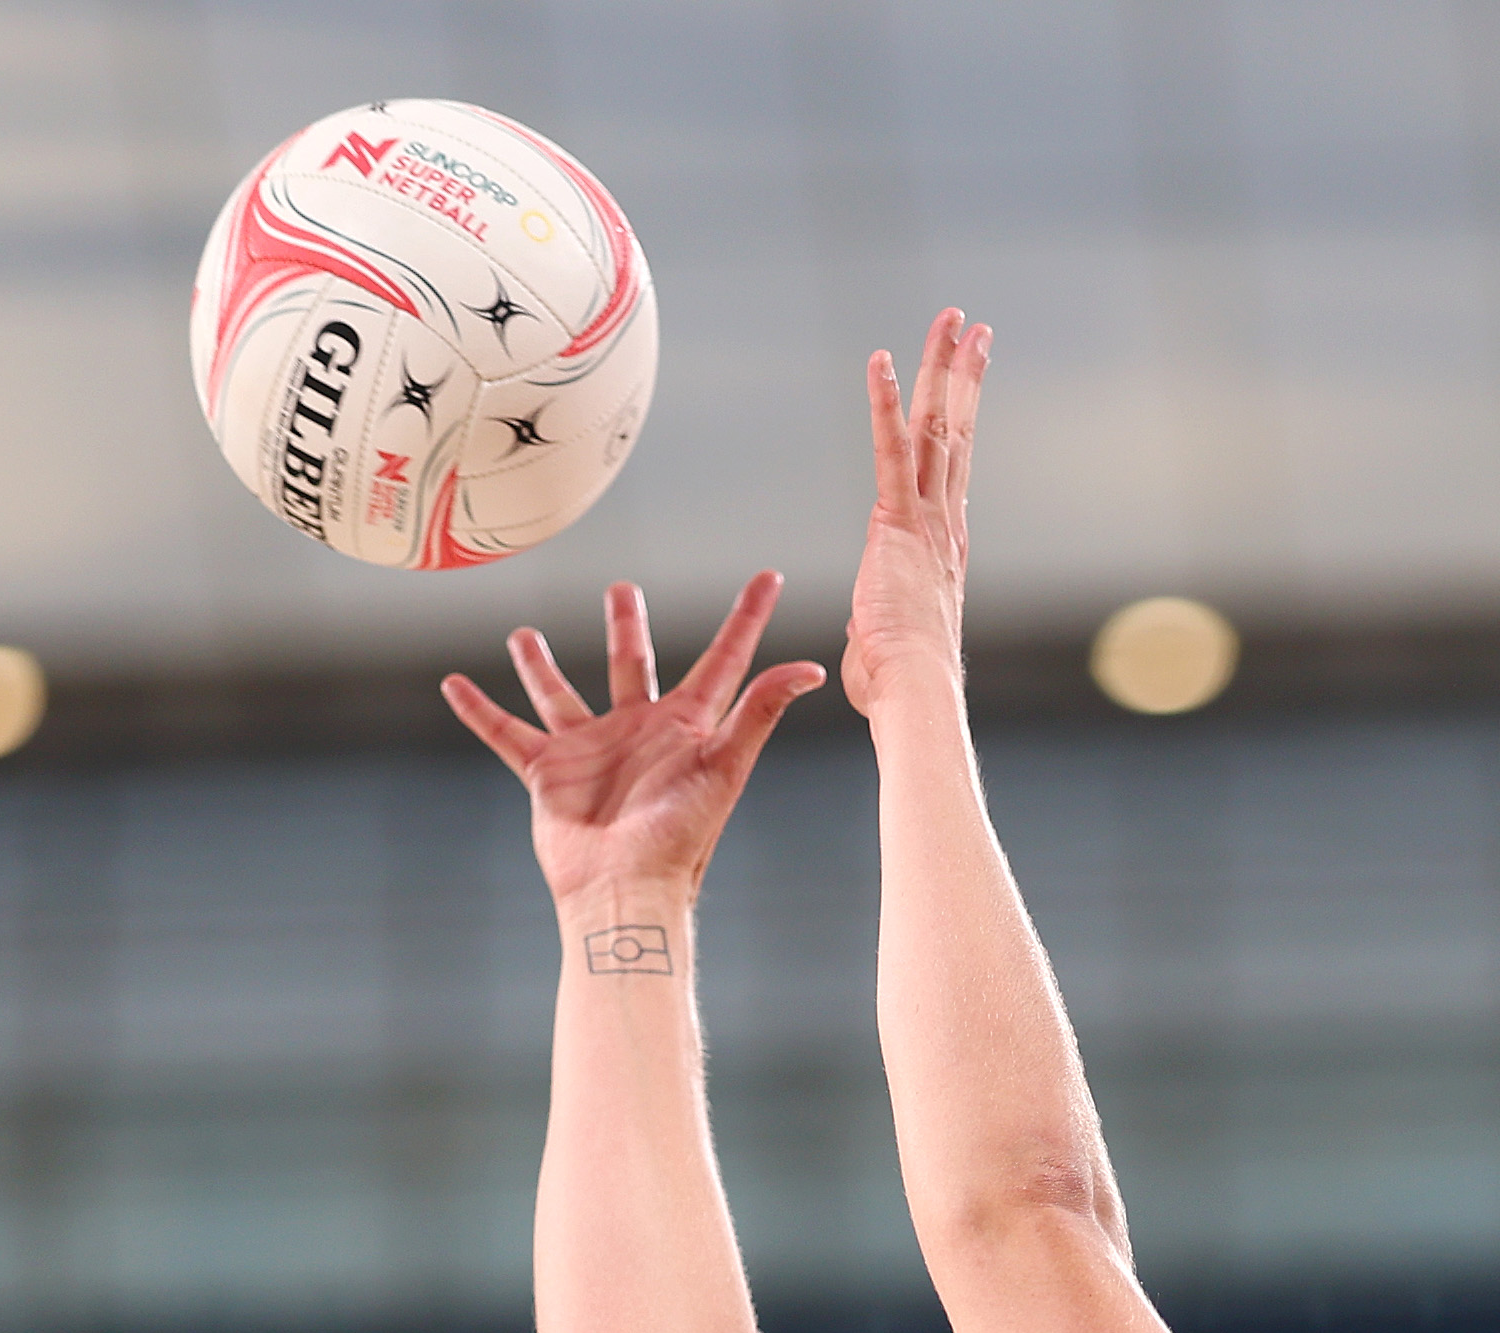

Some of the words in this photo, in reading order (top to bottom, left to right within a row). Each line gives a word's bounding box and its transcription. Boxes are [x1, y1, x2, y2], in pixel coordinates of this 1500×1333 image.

[391, 155, 476, 205] SUPER
[403, 141, 518, 206] SUNCORP
[378, 171, 488, 243] NETBALL
